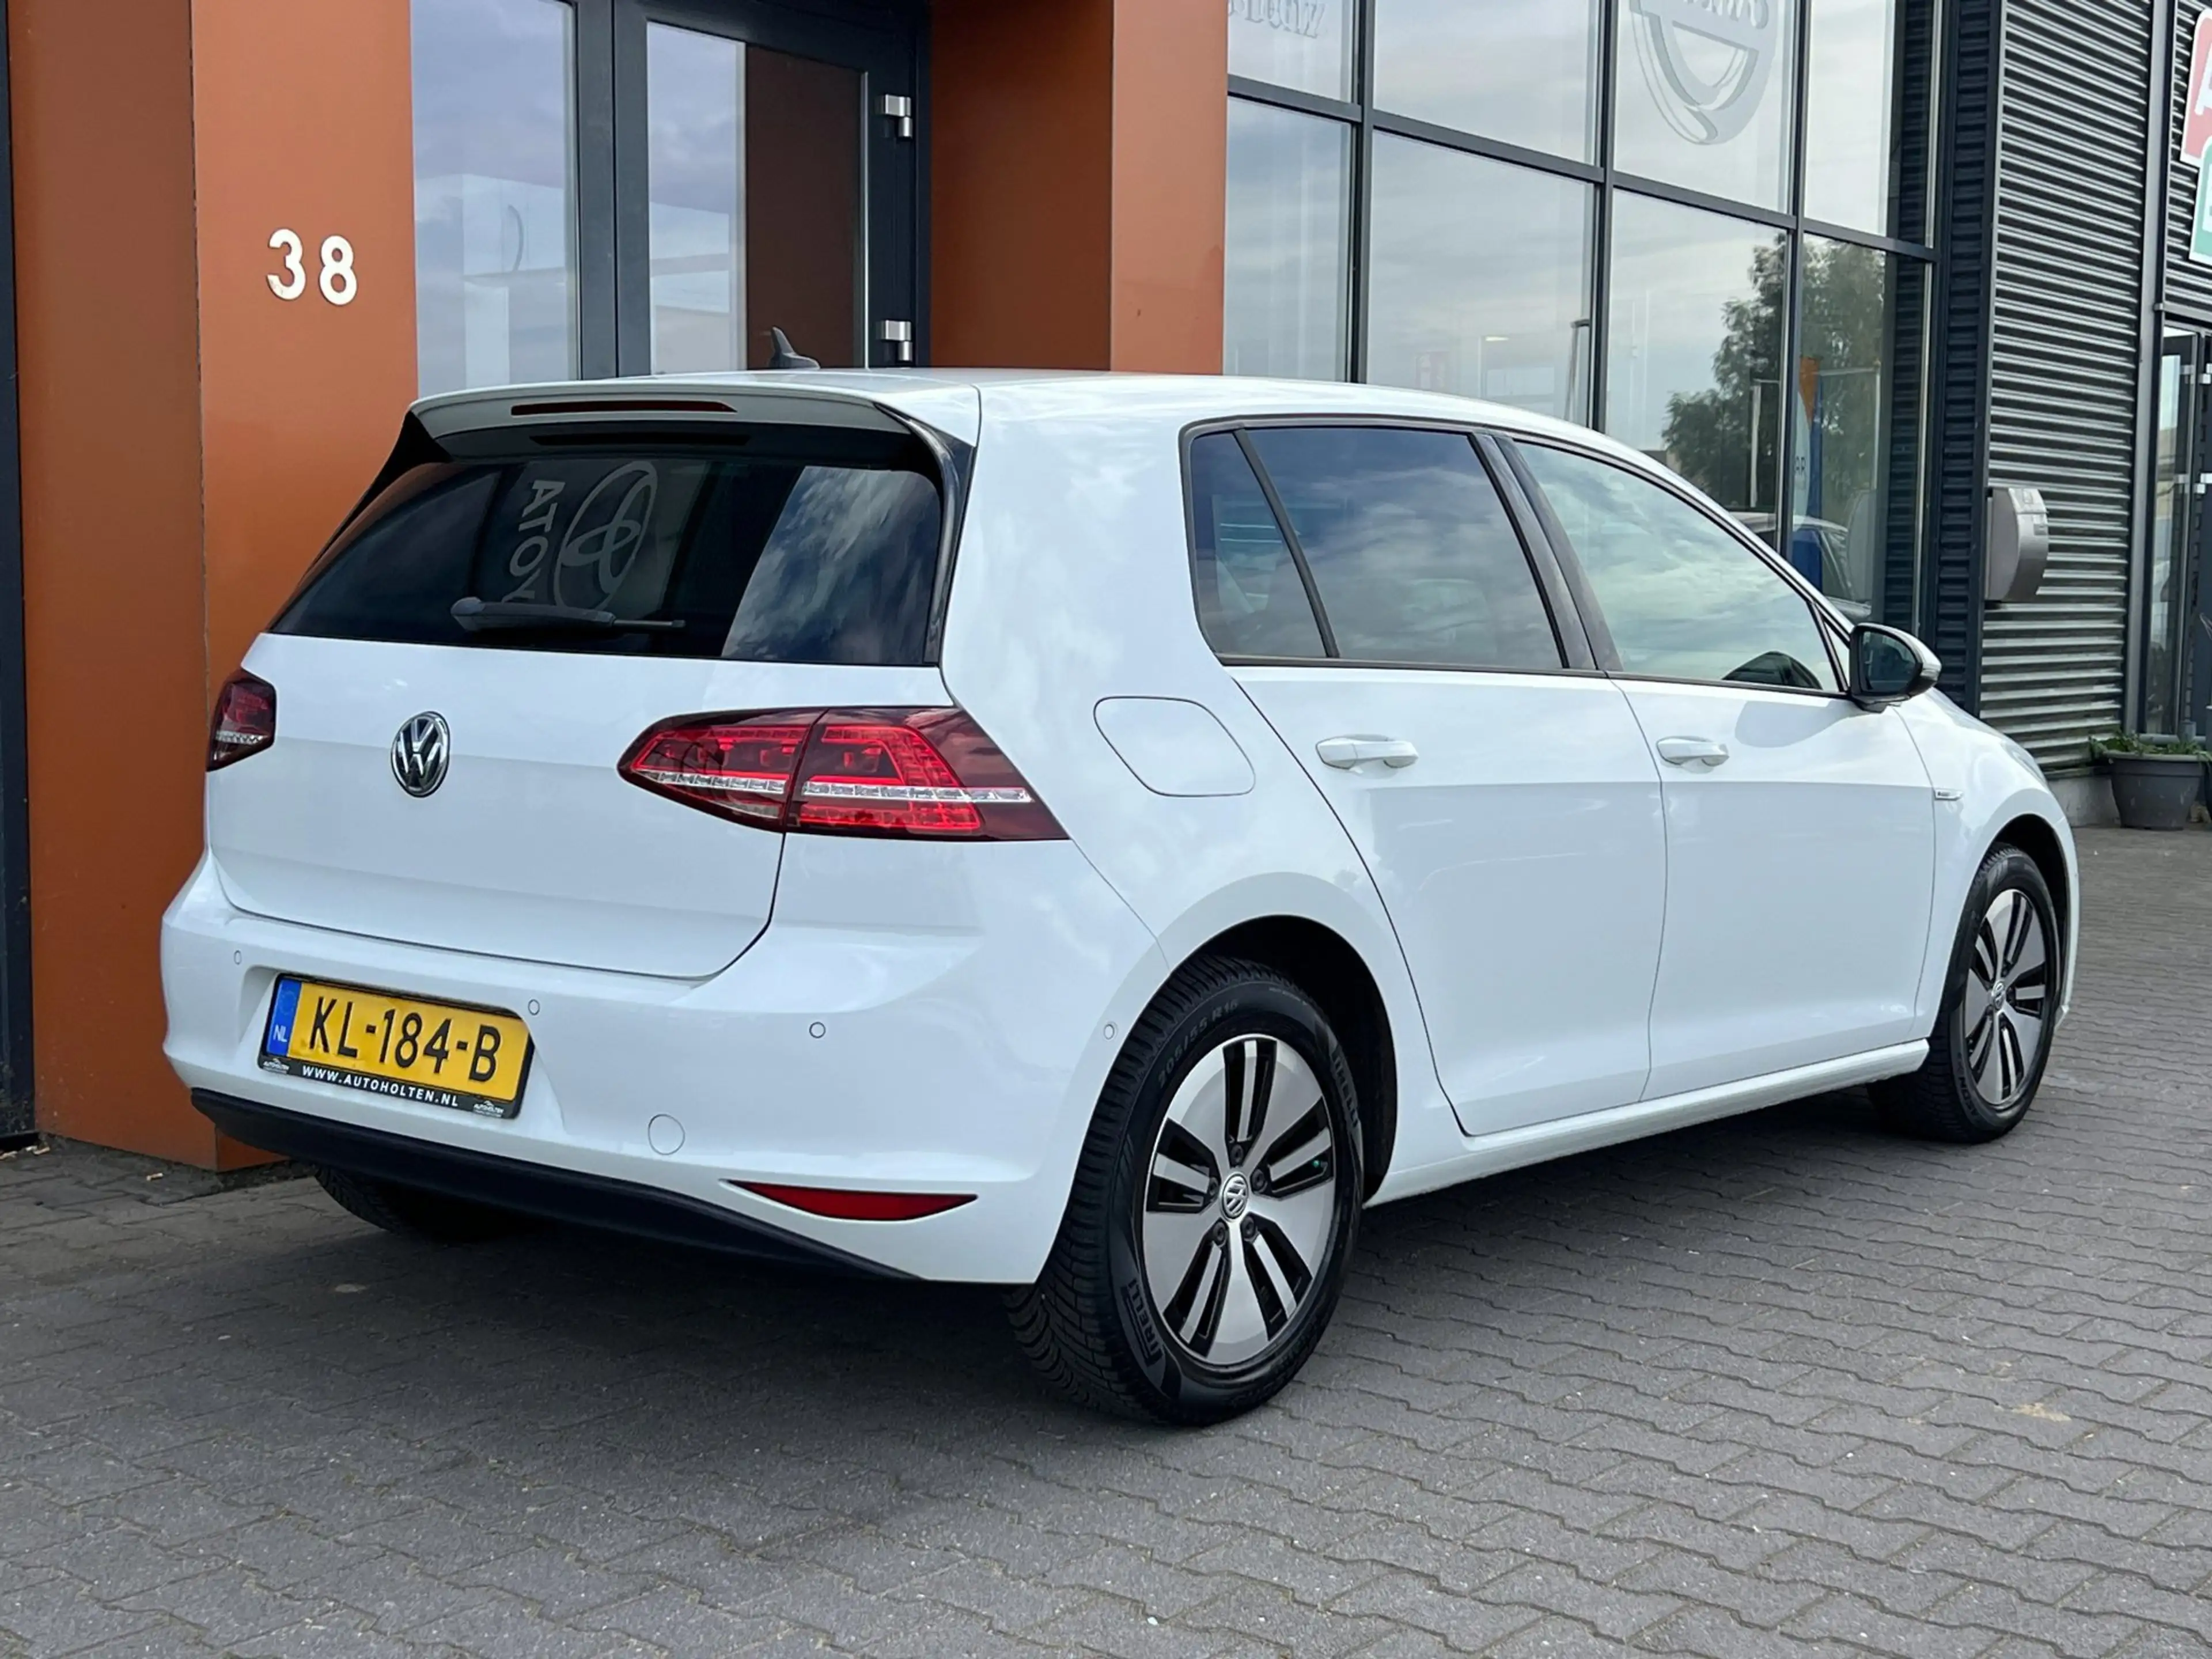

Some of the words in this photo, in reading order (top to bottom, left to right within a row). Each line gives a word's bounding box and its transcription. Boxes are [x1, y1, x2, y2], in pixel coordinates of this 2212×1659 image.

[266, 228, 358, 306] 38
[273, 1025, 288, 1043] NL
[309, 996, 501, 1083] KL-184-B
[302, 1065, 459, 1108] WWW.AUTOHOLTEN.NL
[1120, 1278, 1163, 1367] PIRELLI
